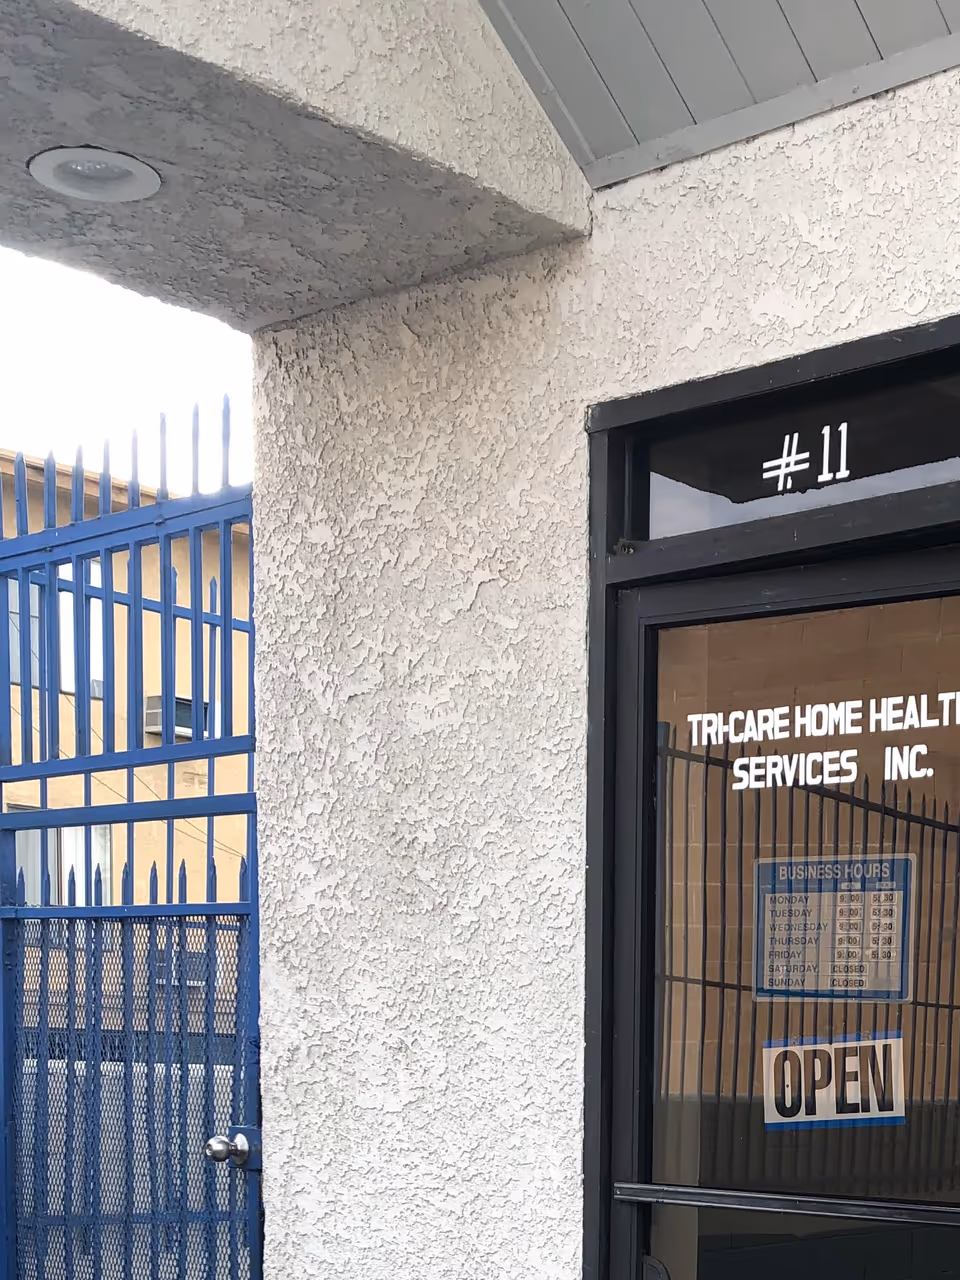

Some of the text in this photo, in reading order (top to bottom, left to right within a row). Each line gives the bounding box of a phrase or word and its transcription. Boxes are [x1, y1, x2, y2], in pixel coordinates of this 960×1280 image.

[687, 706, 790, 747] TRI-CARE
[794, 699, 863, 738] HOME
[731, 744, 934, 790] SERVICES INC.
[779, 862, 890, 881] BUSINESS HOURS
[769, 895, 810, 905] MONDAY
[769, 909, 813, 918] TUESDAY
[769, 923, 828, 932] WEDNESDAY
[769, 937, 819, 946] THURSDAY
[768, 951, 802, 960] FRIDAY
[768, 964, 865, 974] SATURDAY CLOSED
[768, 978, 865, 987] SUNDAY CLOSED
[773, 1043, 894, 1119] OPEN
